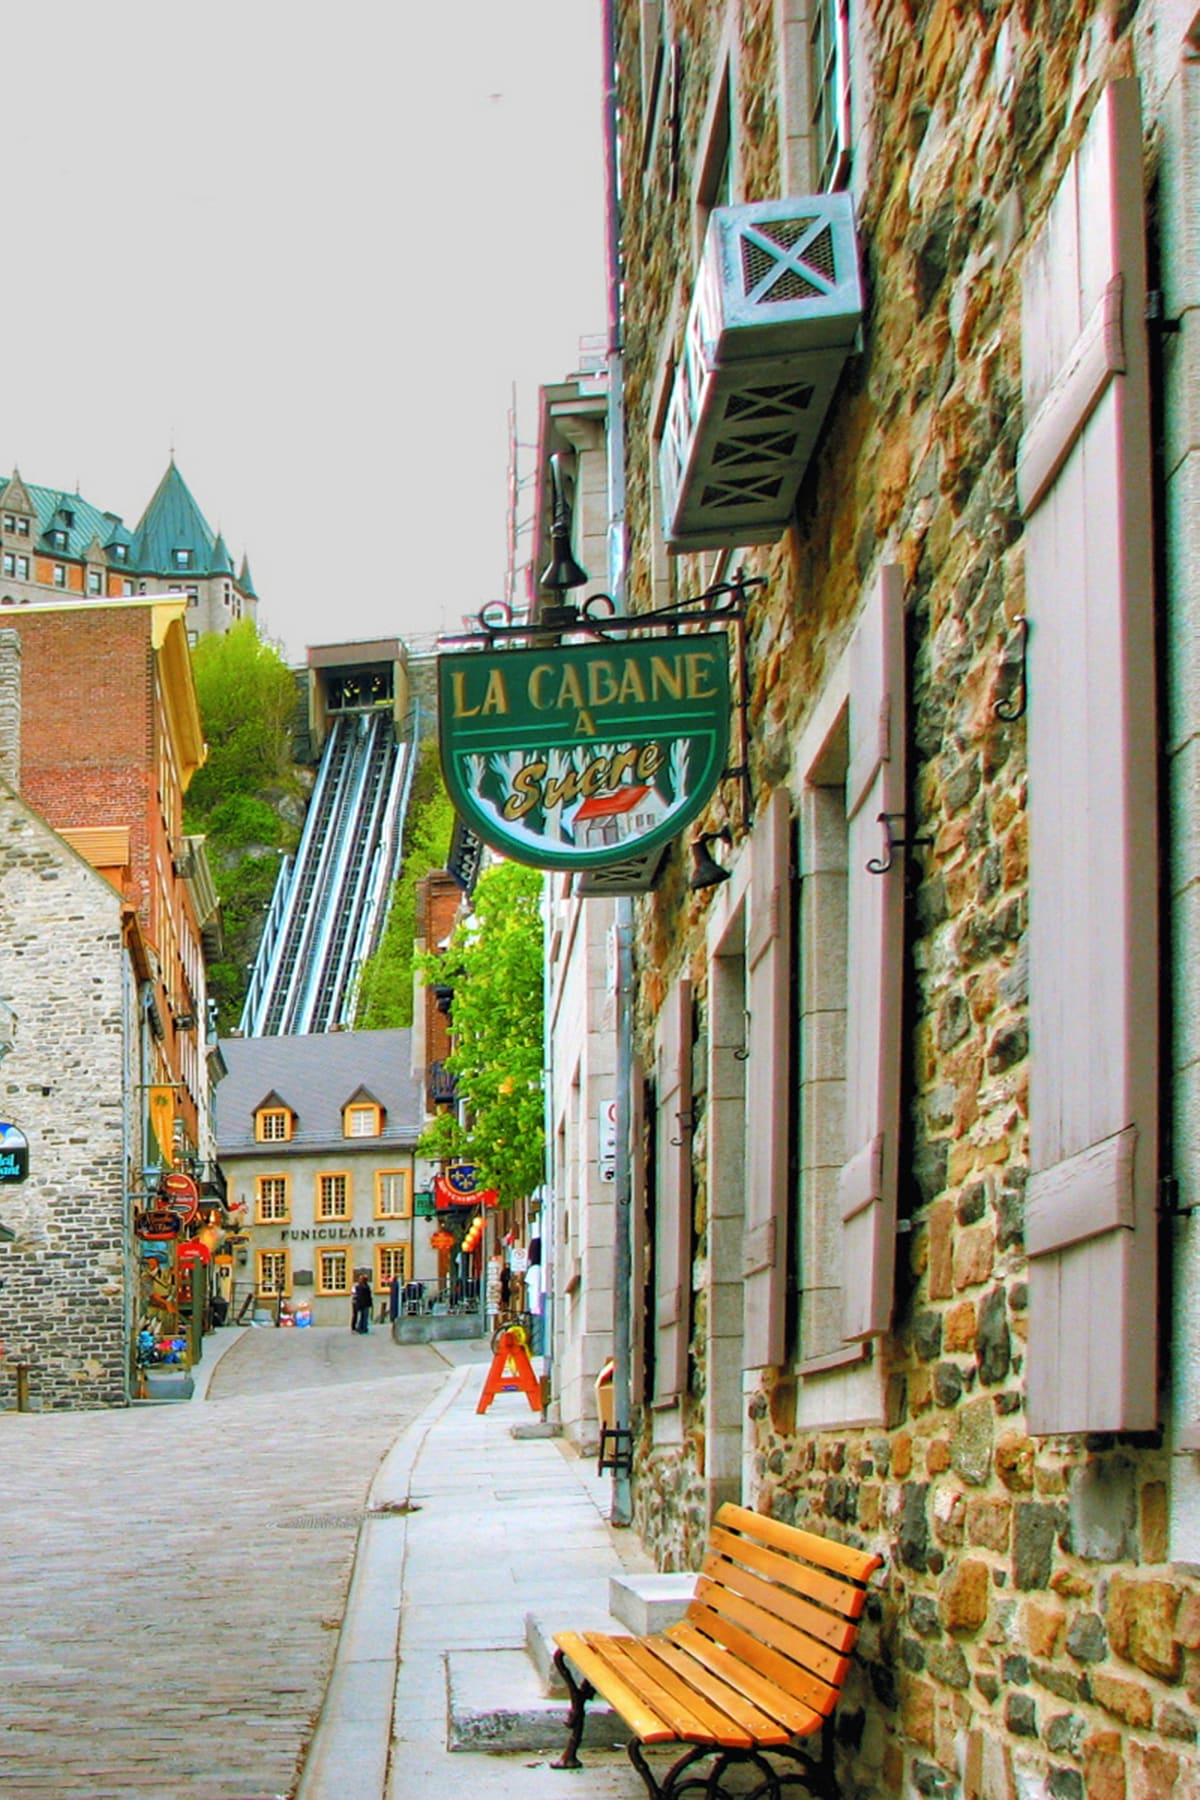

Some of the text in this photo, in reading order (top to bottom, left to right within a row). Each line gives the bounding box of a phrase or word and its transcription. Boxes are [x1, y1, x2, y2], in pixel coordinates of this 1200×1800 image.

[451, 651, 718, 718] LA CABANE
[503, 743, 665, 822] Sucre
[280, 1226, 386, 1241] FUNICULAIRE
